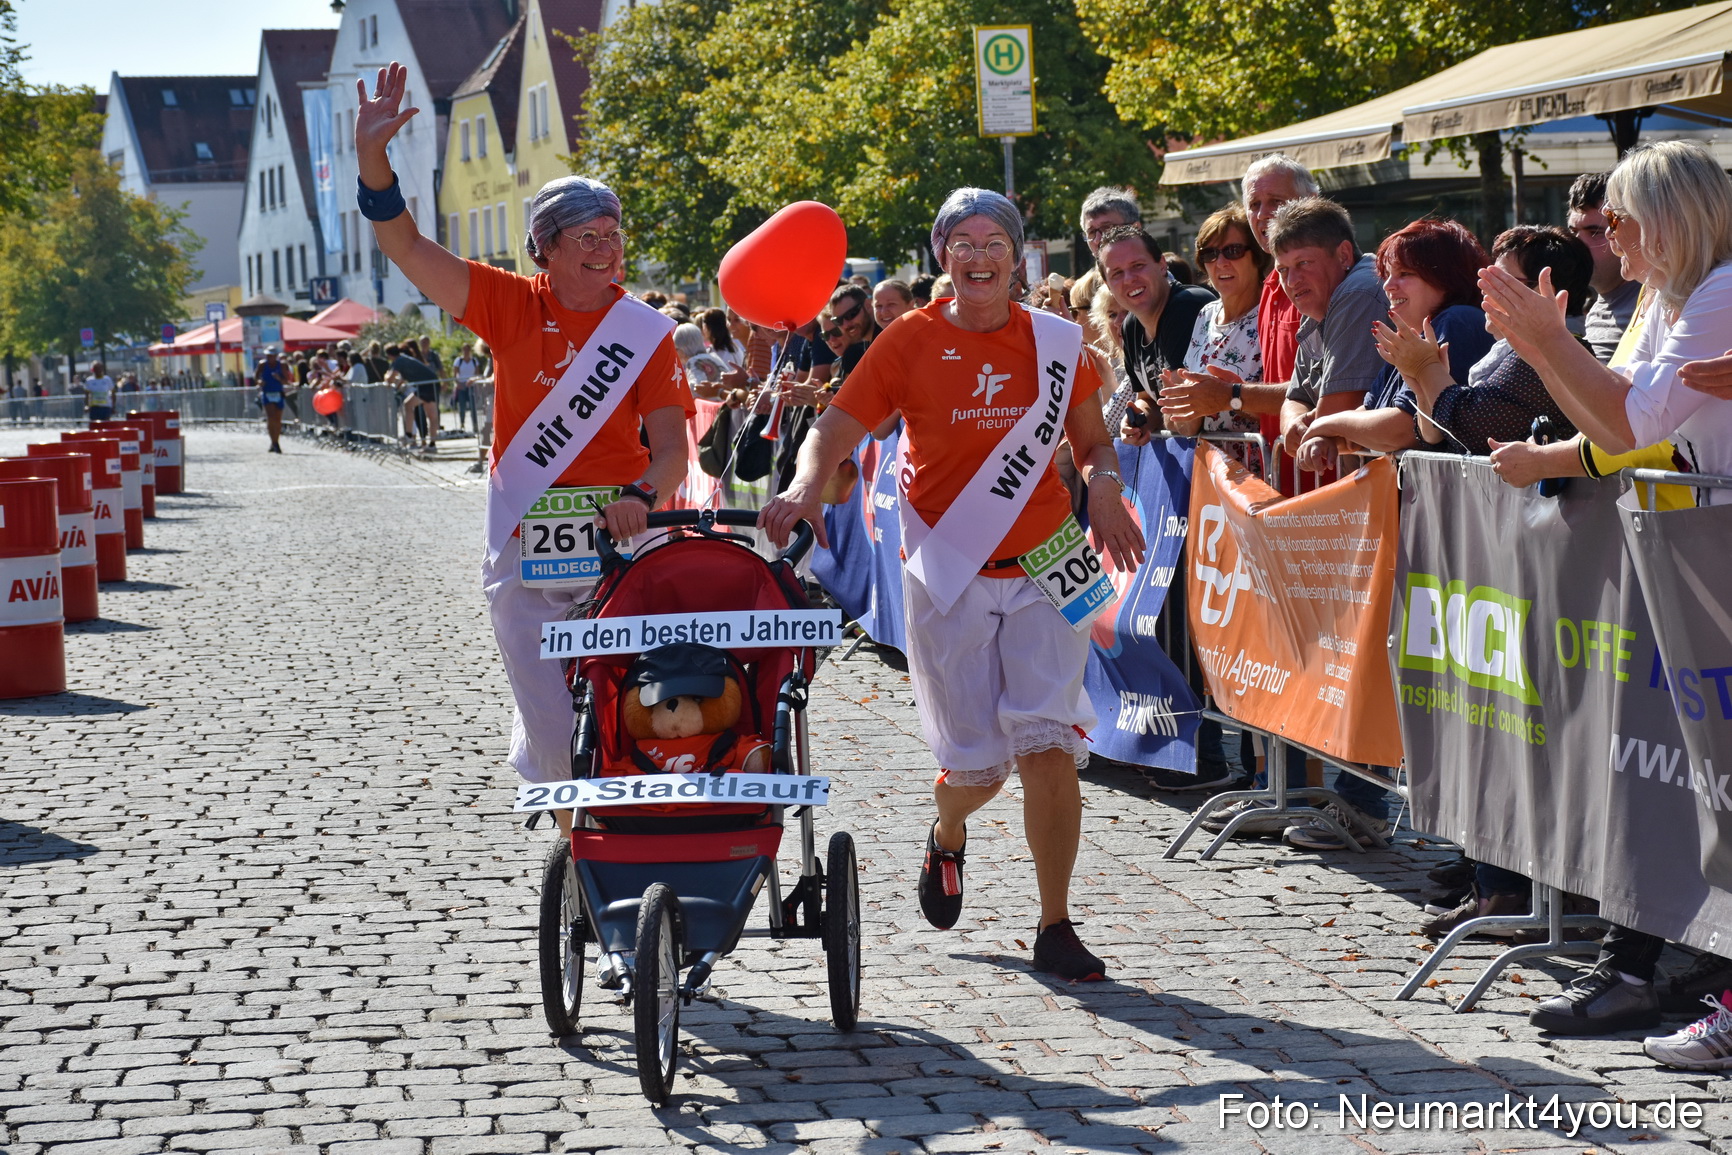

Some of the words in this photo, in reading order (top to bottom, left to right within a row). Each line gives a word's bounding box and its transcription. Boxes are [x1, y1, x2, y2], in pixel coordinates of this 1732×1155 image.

[994, 43, 1014, 66] H
[988, 80, 1023, 89] Marktplatz
[525, 414, 574, 468] wir
[568, 341, 636, 420] auch
[989, 444, 1037, 500] wir
[1033, 360, 1068, 446] auch
[874, 491, 897, 511] ONLINE
[1263, 511, 1301, 528] Neumarkts
[1301, 511, 1340, 527] moderner
[1340, 508, 1370, 525] Partner
[532, 521, 618, 555] 261
[1276, 535, 1286, 551] die
[1286, 535, 1330, 556] Konzeption
[1330, 533, 1346, 551] und
[1301, 559, 1336, 580] Projekte
[1084, 578, 1113, 608] LUISE
[548, 626, 573, 653] in
[582, 622, 631, 650] den
[640, 618, 732, 647] besten
[741, 613, 835, 642] Jahren
[1405, 586, 1526, 690] BOCK
[1227, 648, 1291, 697] Agentur
[521, 776, 822, 808] 20.Stadtlauf
